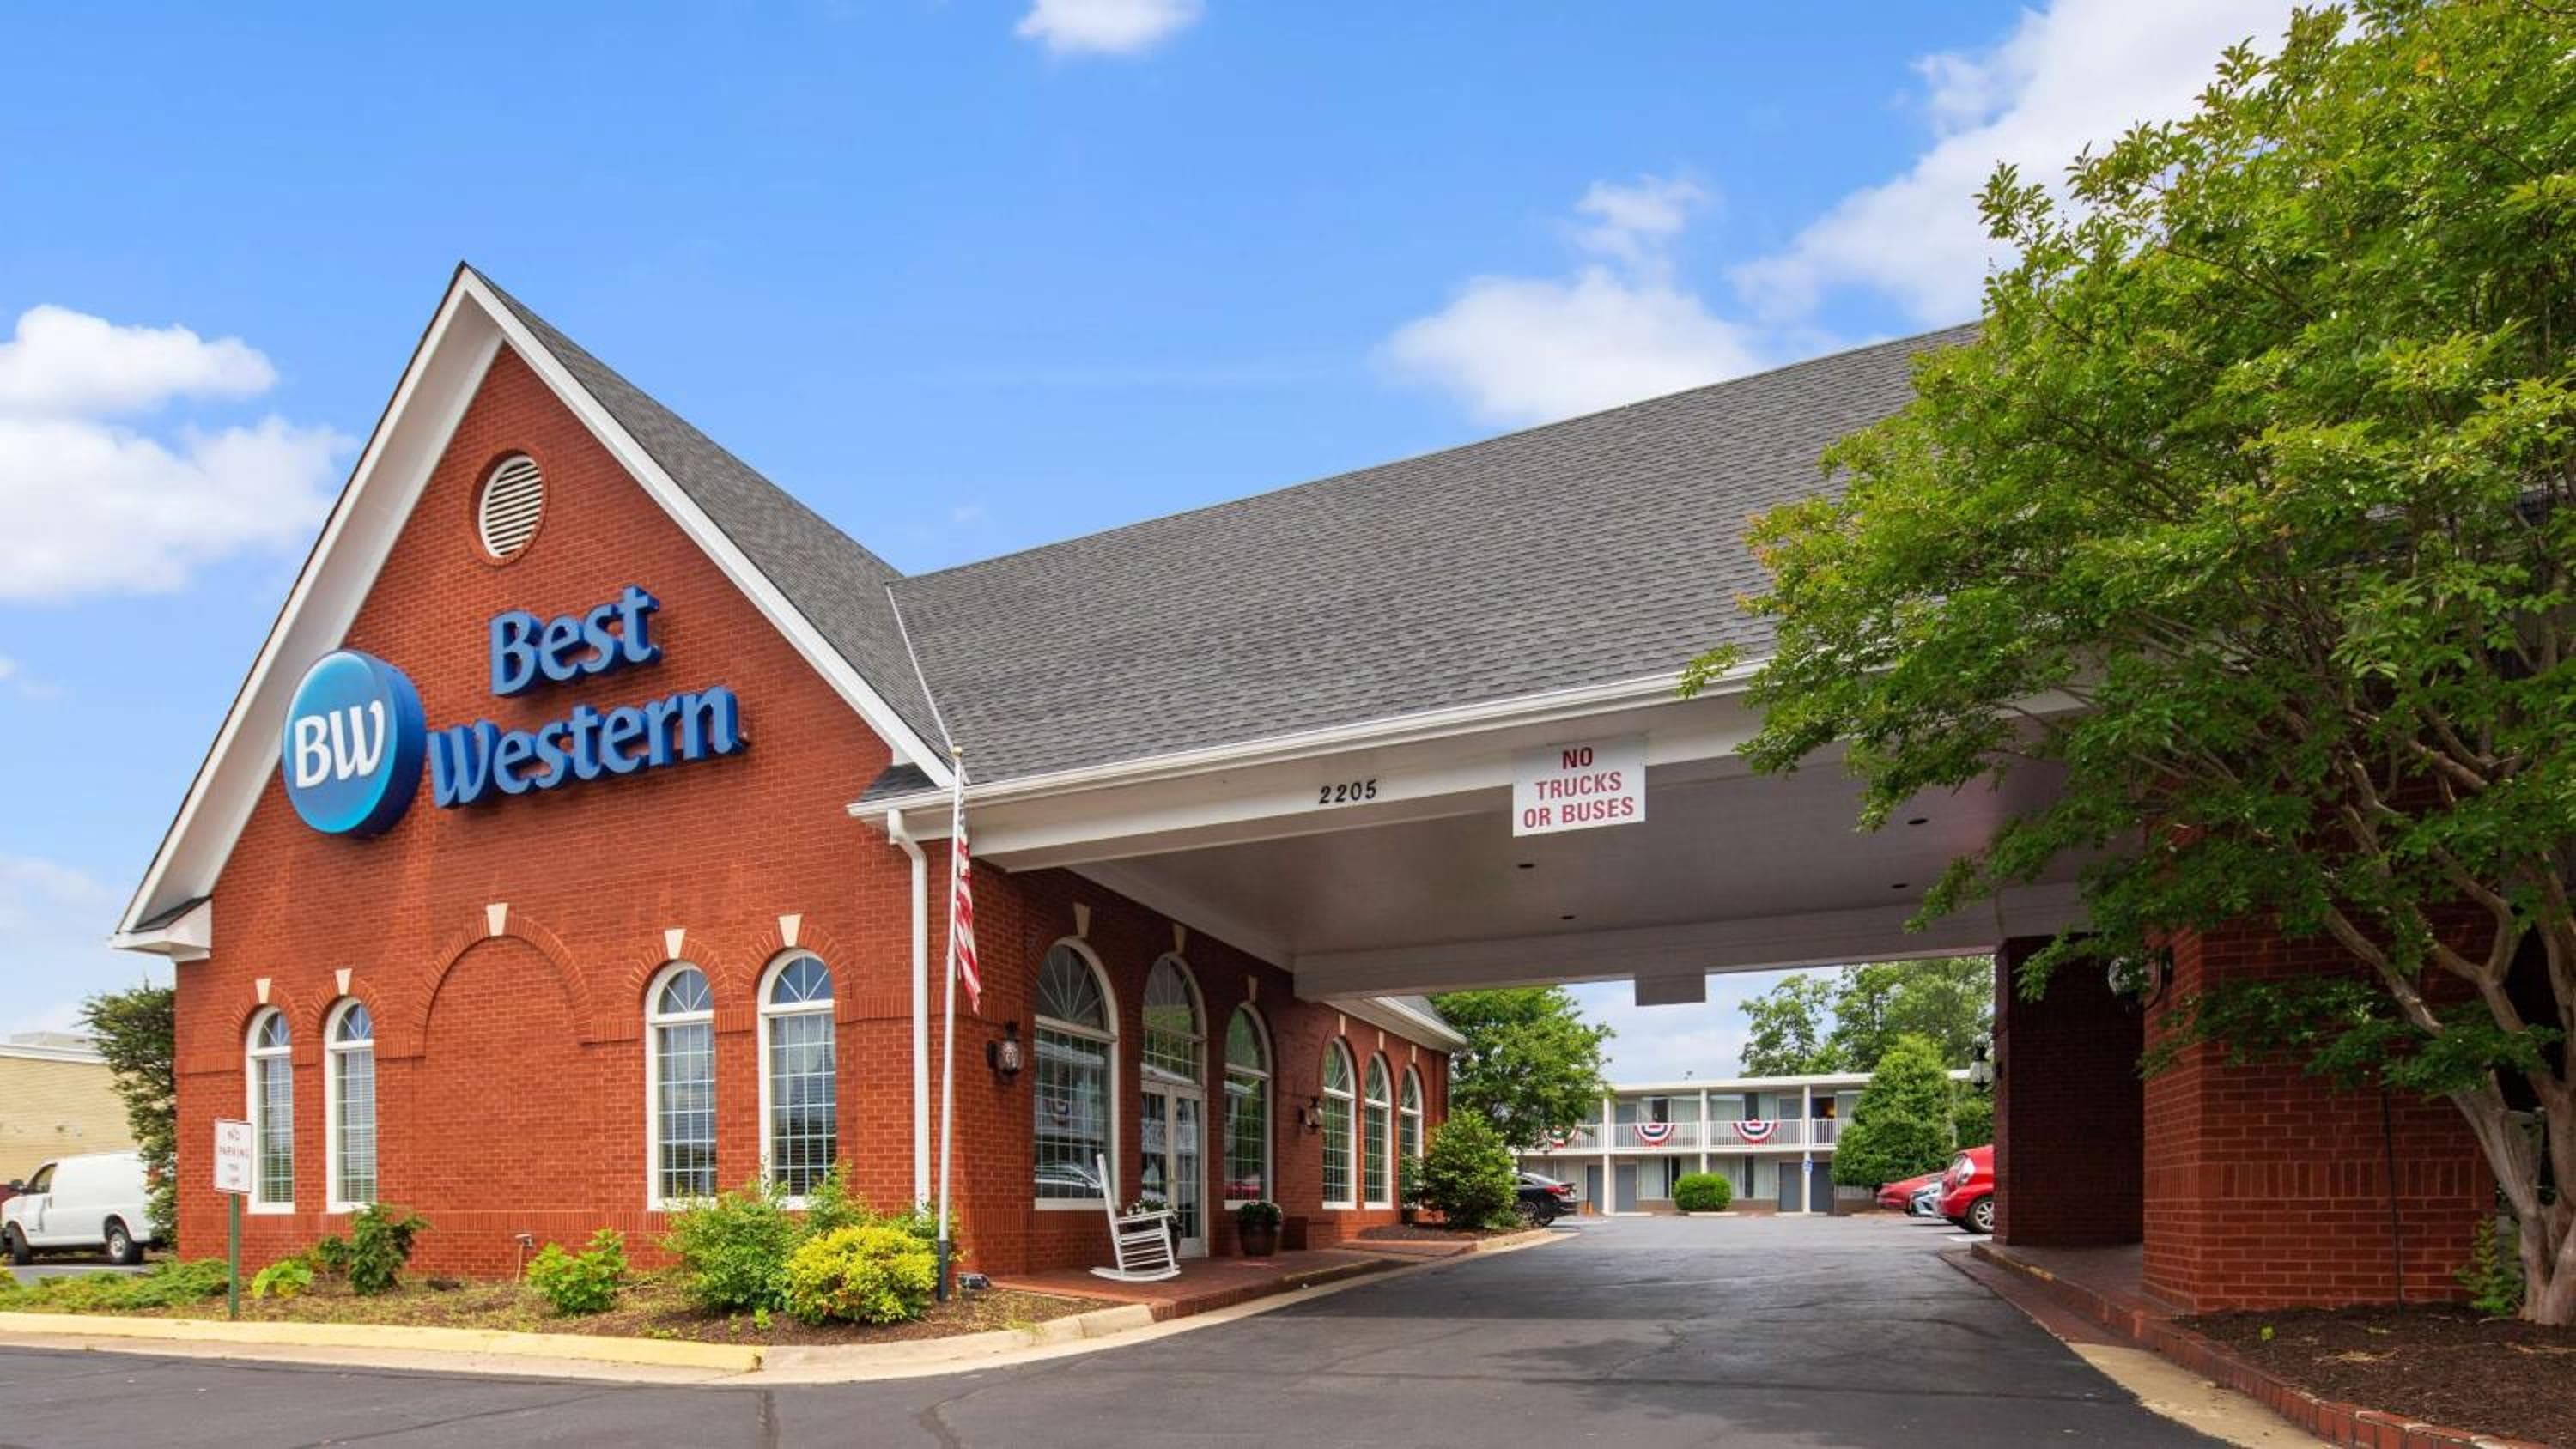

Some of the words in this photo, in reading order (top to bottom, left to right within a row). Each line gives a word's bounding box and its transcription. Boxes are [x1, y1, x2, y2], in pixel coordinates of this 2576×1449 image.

[490, 585, 659, 697] Best
[294, 700, 385, 788] BW
[430, 685, 741, 809] Western
[1562, 747, 1593, 769] NO
[1319, 779, 1377, 803] 2205
[1535, 772, 1622, 800] TRUCKS
[1523, 808, 1551, 828] OR
[1562, 796, 1634, 824] BUSES
